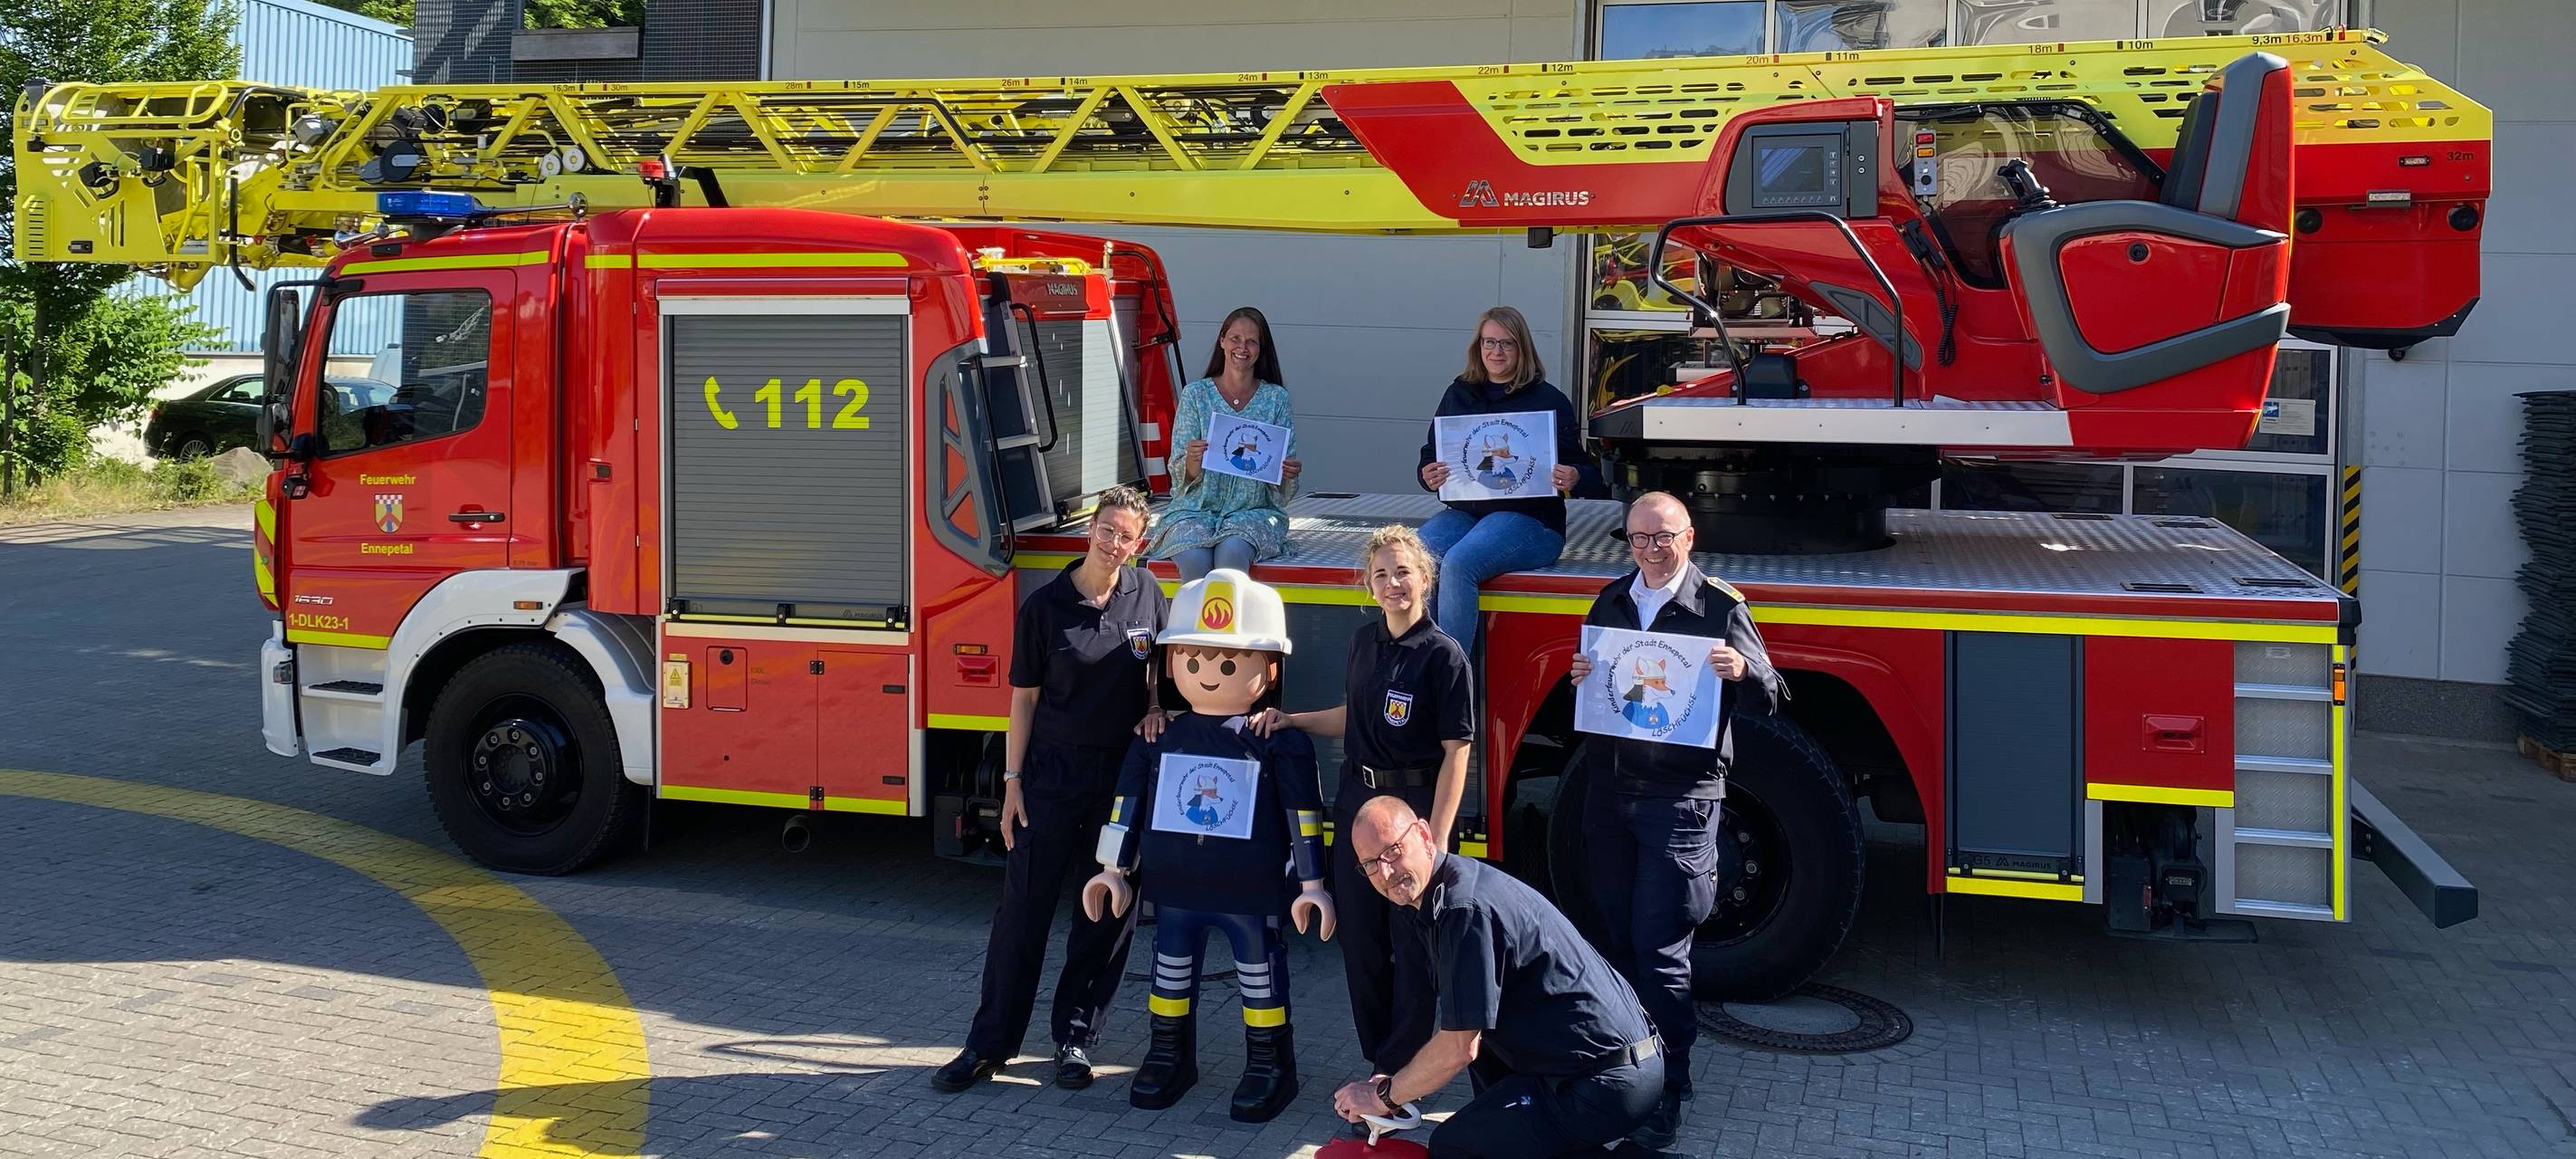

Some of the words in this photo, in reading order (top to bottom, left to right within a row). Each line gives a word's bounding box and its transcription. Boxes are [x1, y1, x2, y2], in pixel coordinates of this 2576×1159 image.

[2252, 35, 2282, 45] 9,3m
[2285, 34, 2323, 43] 16,3m
[2027, 44, 2053, 53] 18m
[2129, 41, 2153, 50] 10m
[1746, 55, 1770, 64] 20m
[1836, 53, 1859, 61] 11m
[1478, 66, 1499, 75] 22m
[1551, 64, 1573, 72] 12m
[1238, 73, 1258, 81] 24m
[610, 83, 628, 91] 30m
[2447, 151, 2475, 161] 32m
[1503, 191, 1590, 207] MAGIRUS
[754, 378, 870, 429] 112
[359, 474, 416, 485] Feuerwehr
[361, 543, 414, 556] Ennepetal
[289, 613, 349, 630] 1-DLK23-1
[1605, 653, 1622, 714] Kinderfeuerwehr
[1622, 644, 1634, 656] der
[1635, 638, 1657, 648] Stadt
[1658, 640, 1693, 669] Ennepetal
[1652, 693, 1697, 737] LÖSCHFÜCHSE
[1972, 854, 1991, 866] G5
[2012, 861, 2051, 870] MAGIRUS
